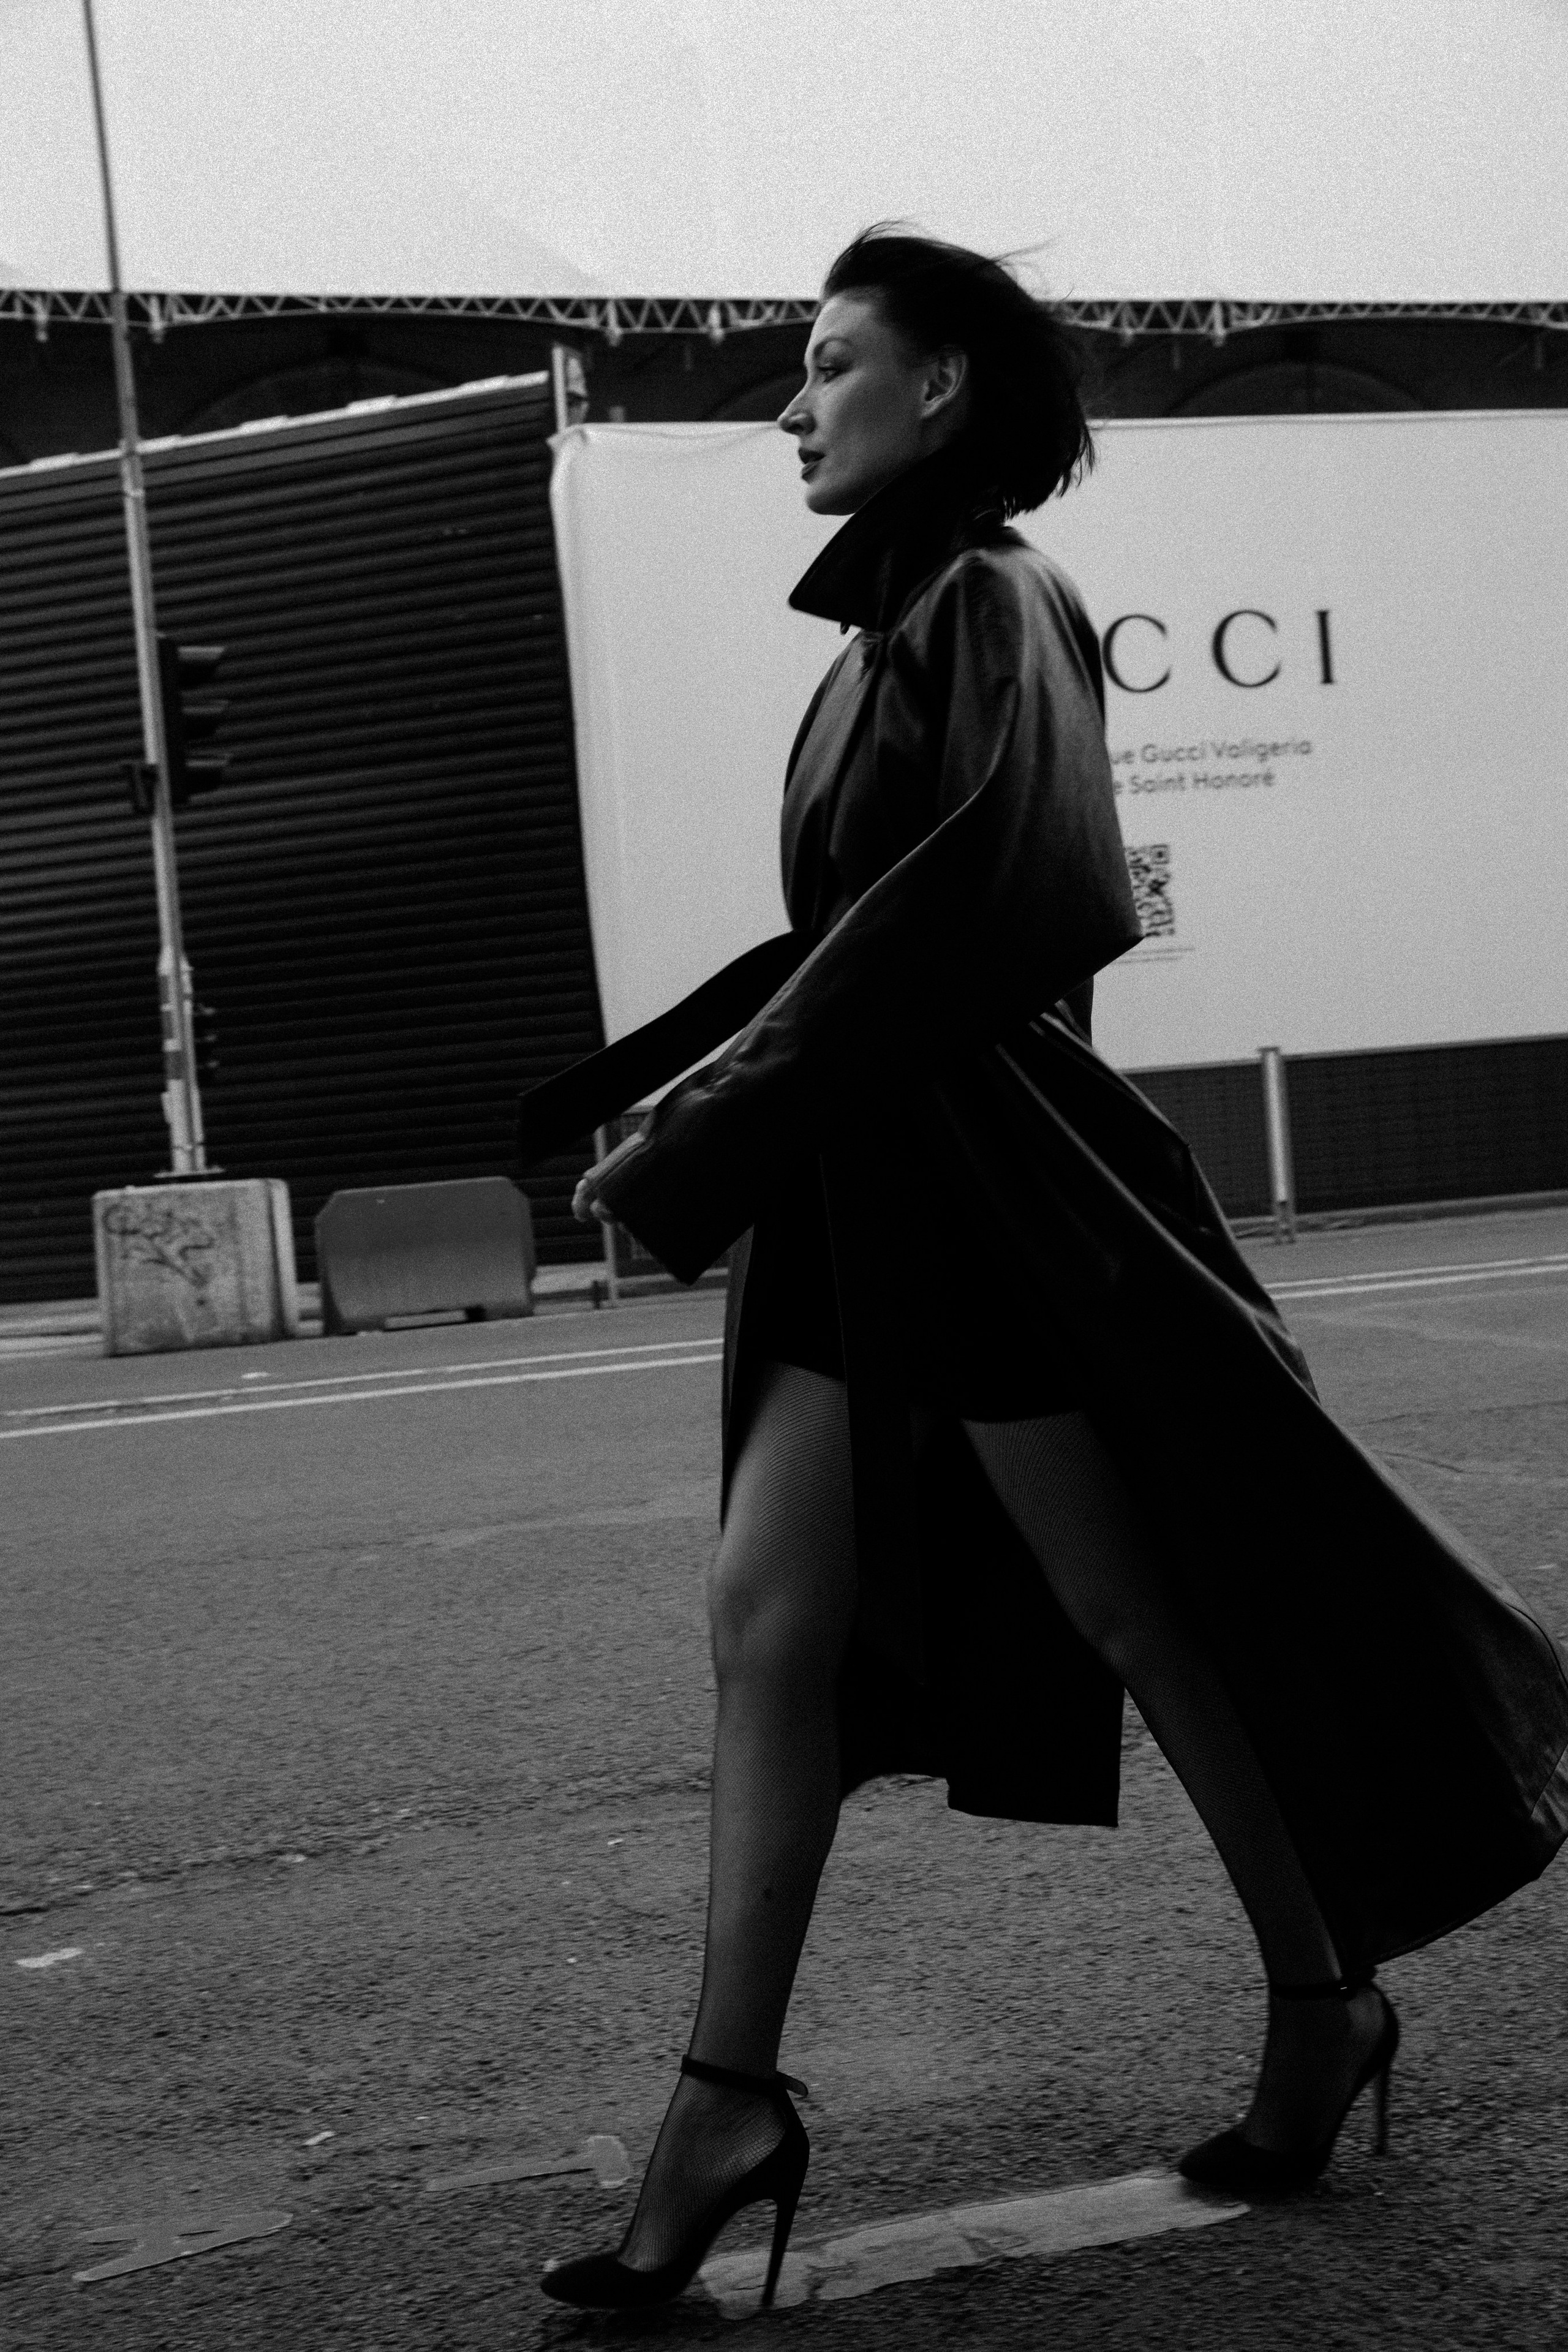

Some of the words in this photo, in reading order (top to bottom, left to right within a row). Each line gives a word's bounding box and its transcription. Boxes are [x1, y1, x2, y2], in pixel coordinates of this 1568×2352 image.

[1102, 609, 1335, 693] CCI
[1140, 741, 1205, 763] Gucci
[1129, 774, 1186, 794] Saint
